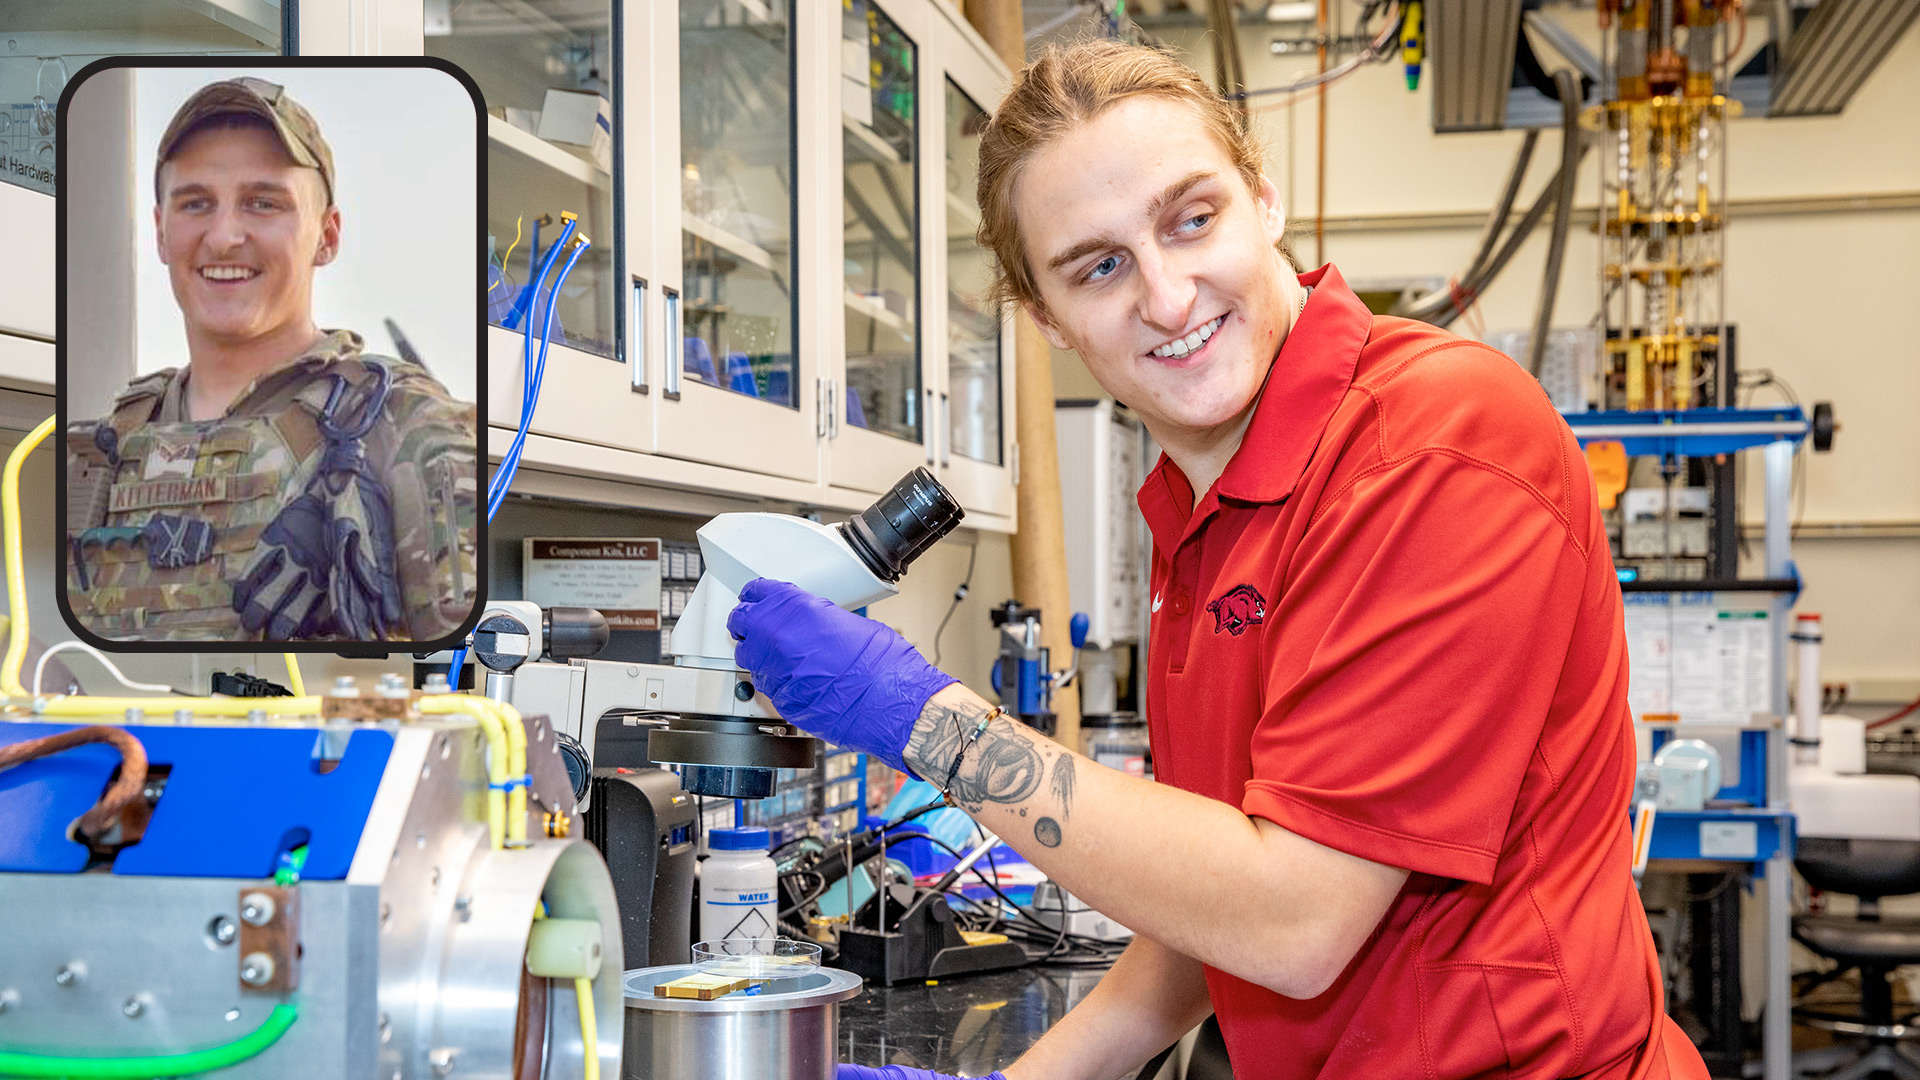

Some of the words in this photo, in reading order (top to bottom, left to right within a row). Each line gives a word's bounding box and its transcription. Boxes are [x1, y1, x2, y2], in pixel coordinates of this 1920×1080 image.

[116, 477, 216, 507] KITTERMAN
[913, 484, 933, 507] OLYMPUS
[549, 545, 601, 559] Component
[626, 545, 648, 558] LLC
[738, 892, 769, 902] WATER
